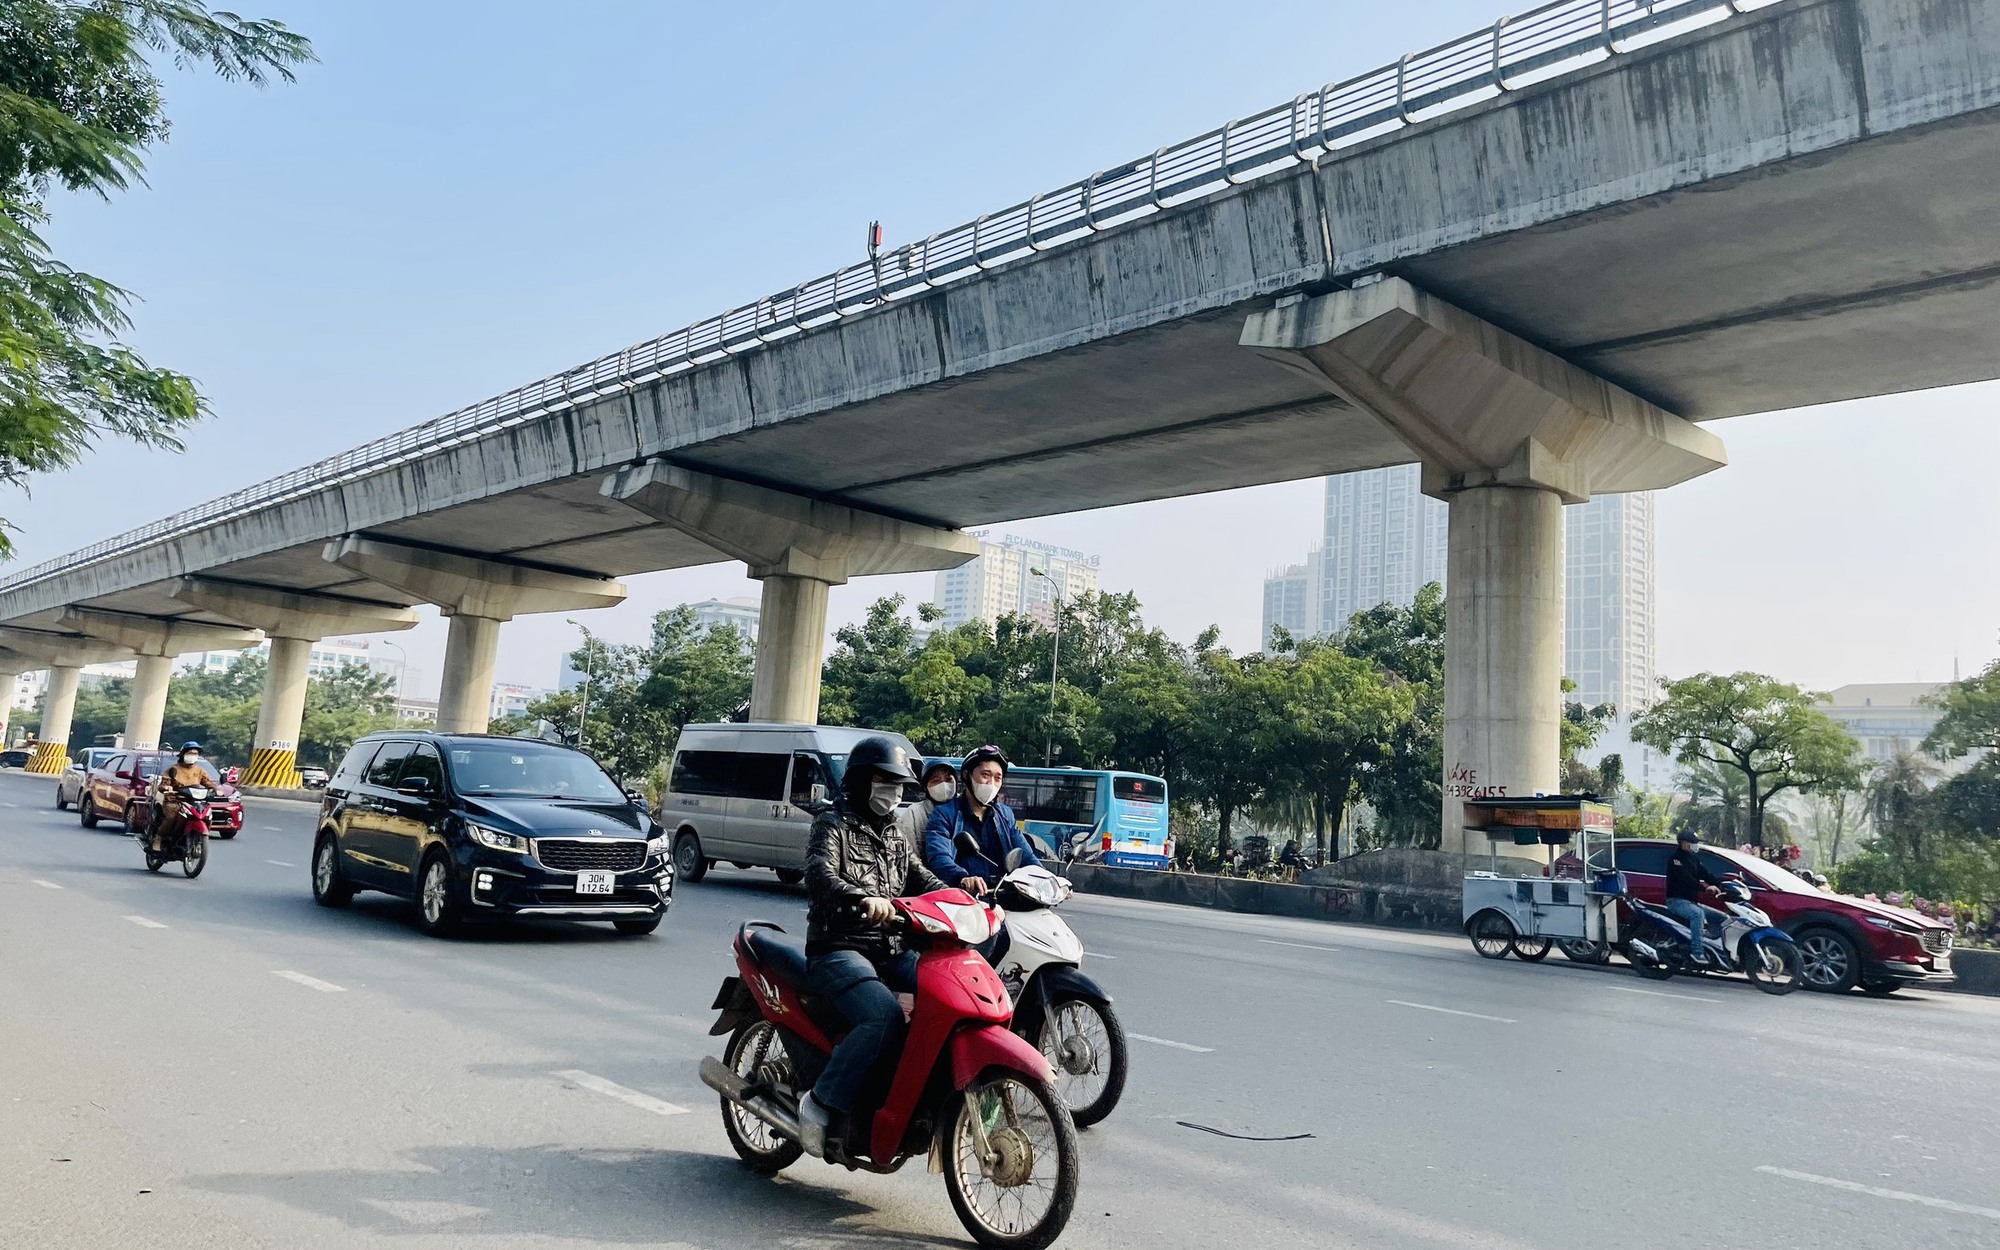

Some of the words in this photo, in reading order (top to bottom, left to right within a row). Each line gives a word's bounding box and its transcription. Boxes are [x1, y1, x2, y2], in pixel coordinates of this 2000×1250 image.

[1005, 534, 1020, 545] FLC
[1020, 537, 1058, 555] LANDMARK
[1060, 547, 1084, 561] TOWER
[588, 874, 605, 883] 30H
[581, 883, 610, 893] 112.64
